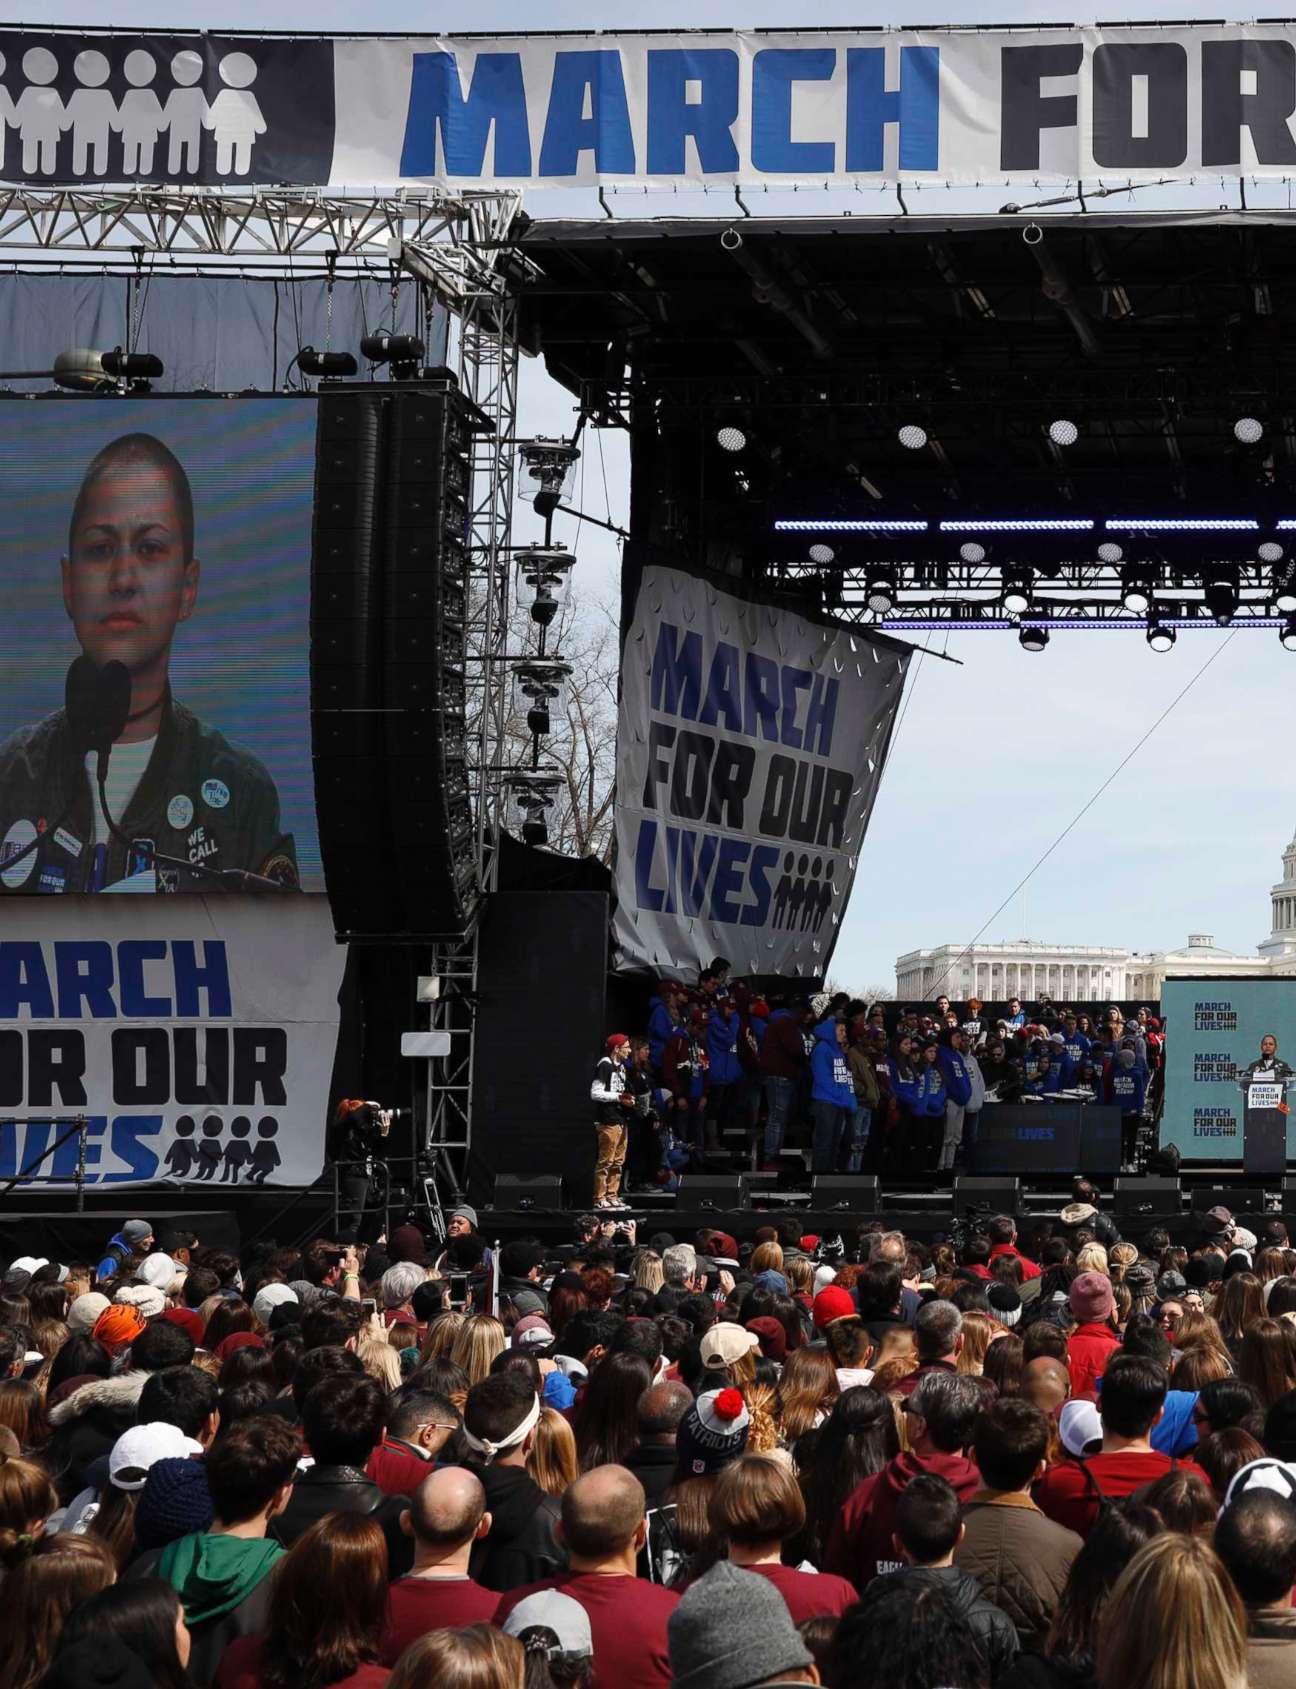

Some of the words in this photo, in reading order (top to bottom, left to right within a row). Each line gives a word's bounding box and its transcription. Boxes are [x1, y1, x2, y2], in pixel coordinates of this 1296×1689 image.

[400, 46, 939, 177] MARCH
[650, 622, 840, 758] MARCH
[642, 721, 756, 829] FOR
[758, 753, 855, 849] OUR
[188, 826, 206, 846] WE
[189, 839, 219, 864] CALL
[635, 819, 780, 927] LIVES
[1194, 1002, 1231, 1011] MARCH
[1194, 1012, 1214, 1021] FOR
[1216, 1012, 1237, 1021] OUR
[1194, 1022, 1222, 1031] LIVES
[1194, 1054, 1231, 1062] MARCH
[112, 1027, 288, 1107] OUR
[1194, 1064, 1214, 1072] FOR
[1216, 1064, 1237, 1072] OUR
[1194, 1073, 1222, 1082] LIVES
[1194, 1108, 1231, 1117] MARCH
[1194, 1118, 1214, 1127] FOR
[1216, 1118, 1237, 1127] OUR
[1194, 1128, 1222, 1136] LIVES
[688, 1410, 742, 1449] PATRIOTS
